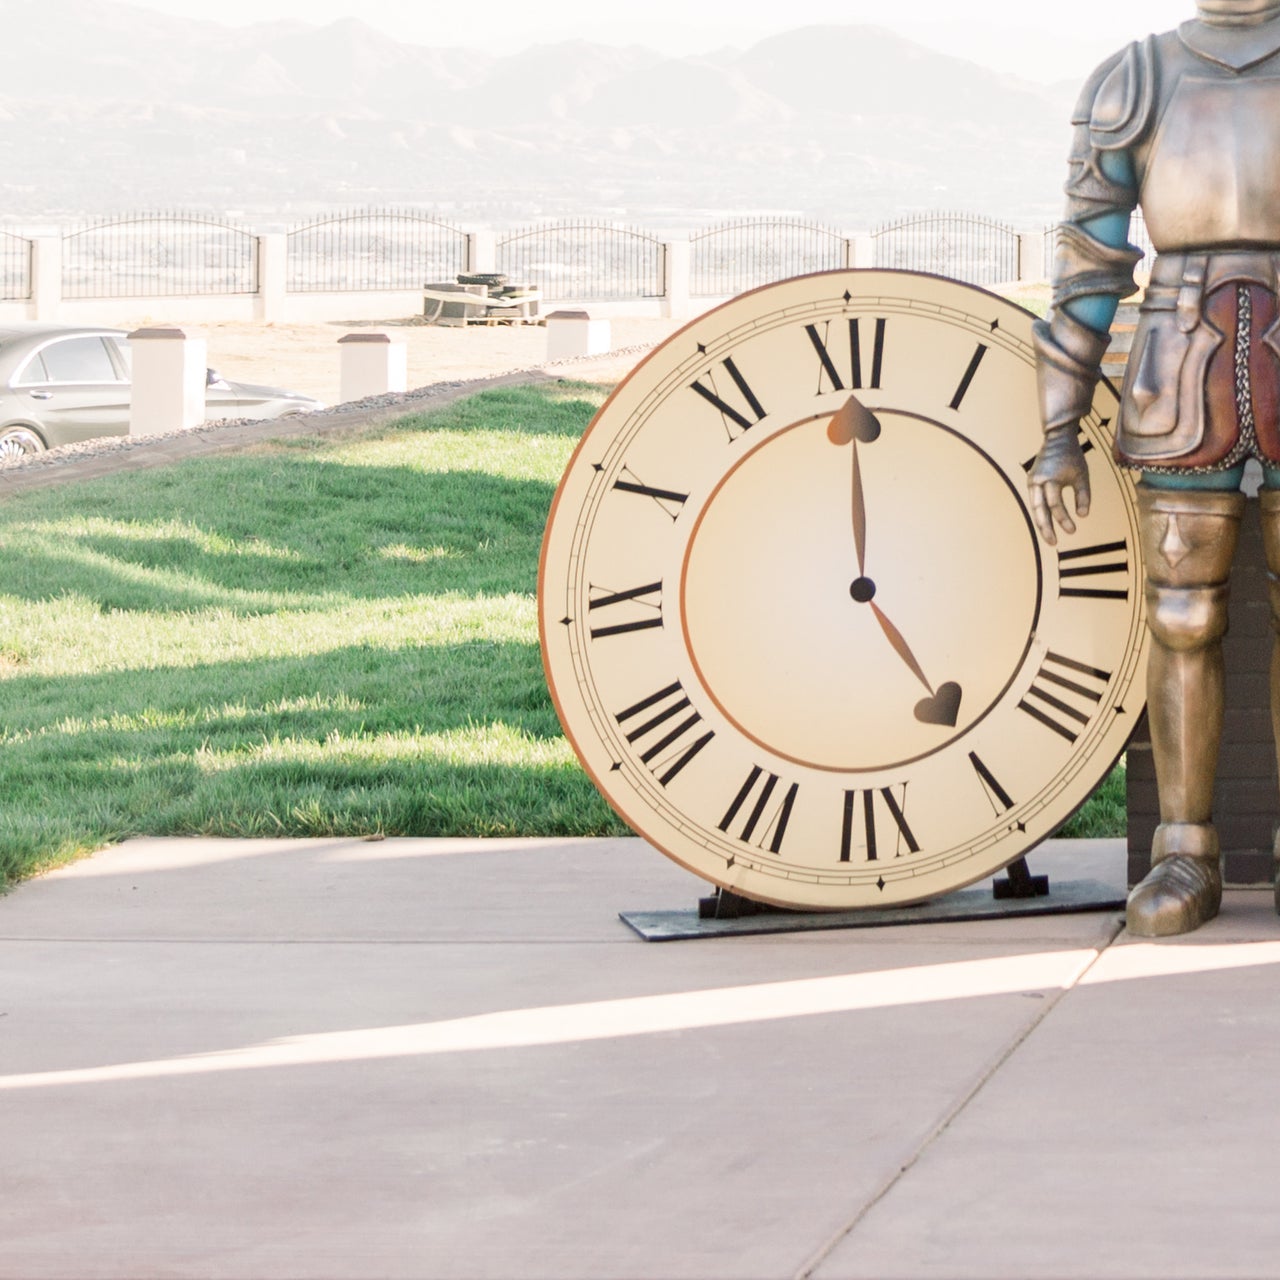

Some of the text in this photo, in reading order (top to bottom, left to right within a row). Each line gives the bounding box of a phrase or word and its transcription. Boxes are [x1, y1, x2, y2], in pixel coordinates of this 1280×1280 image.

[801, 317, 887, 396] XII
[947, 342, 989, 412] I
[688, 355, 769, 444] XI
[611, 462, 690, 523] X
[1056, 536, 1129, 605] III
[588, 577, 664, 643] IX
[613, 677, 716, 790] VIII
[1015, 648, 1113, 746] IIII
[714, 763, 800, 857] VII
[967, 748, 1017, 818] V
